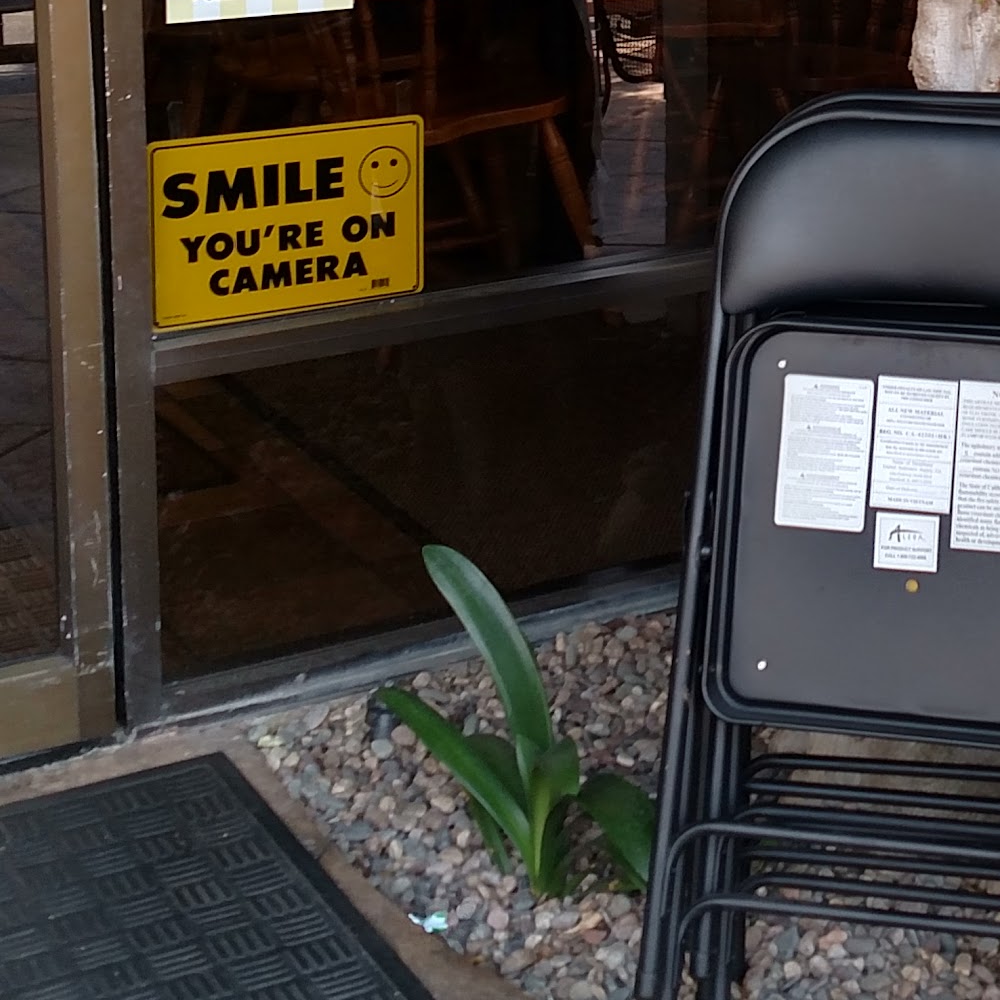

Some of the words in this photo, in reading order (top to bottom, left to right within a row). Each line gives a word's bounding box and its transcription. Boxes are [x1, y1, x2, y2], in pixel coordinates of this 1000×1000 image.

[162, 156, 345, 219] SMILE
[180, 220, 324, 263] YOU'RE
[341, 211, 395, 243] ON
[209, 251, 368, 297] CAMERA
